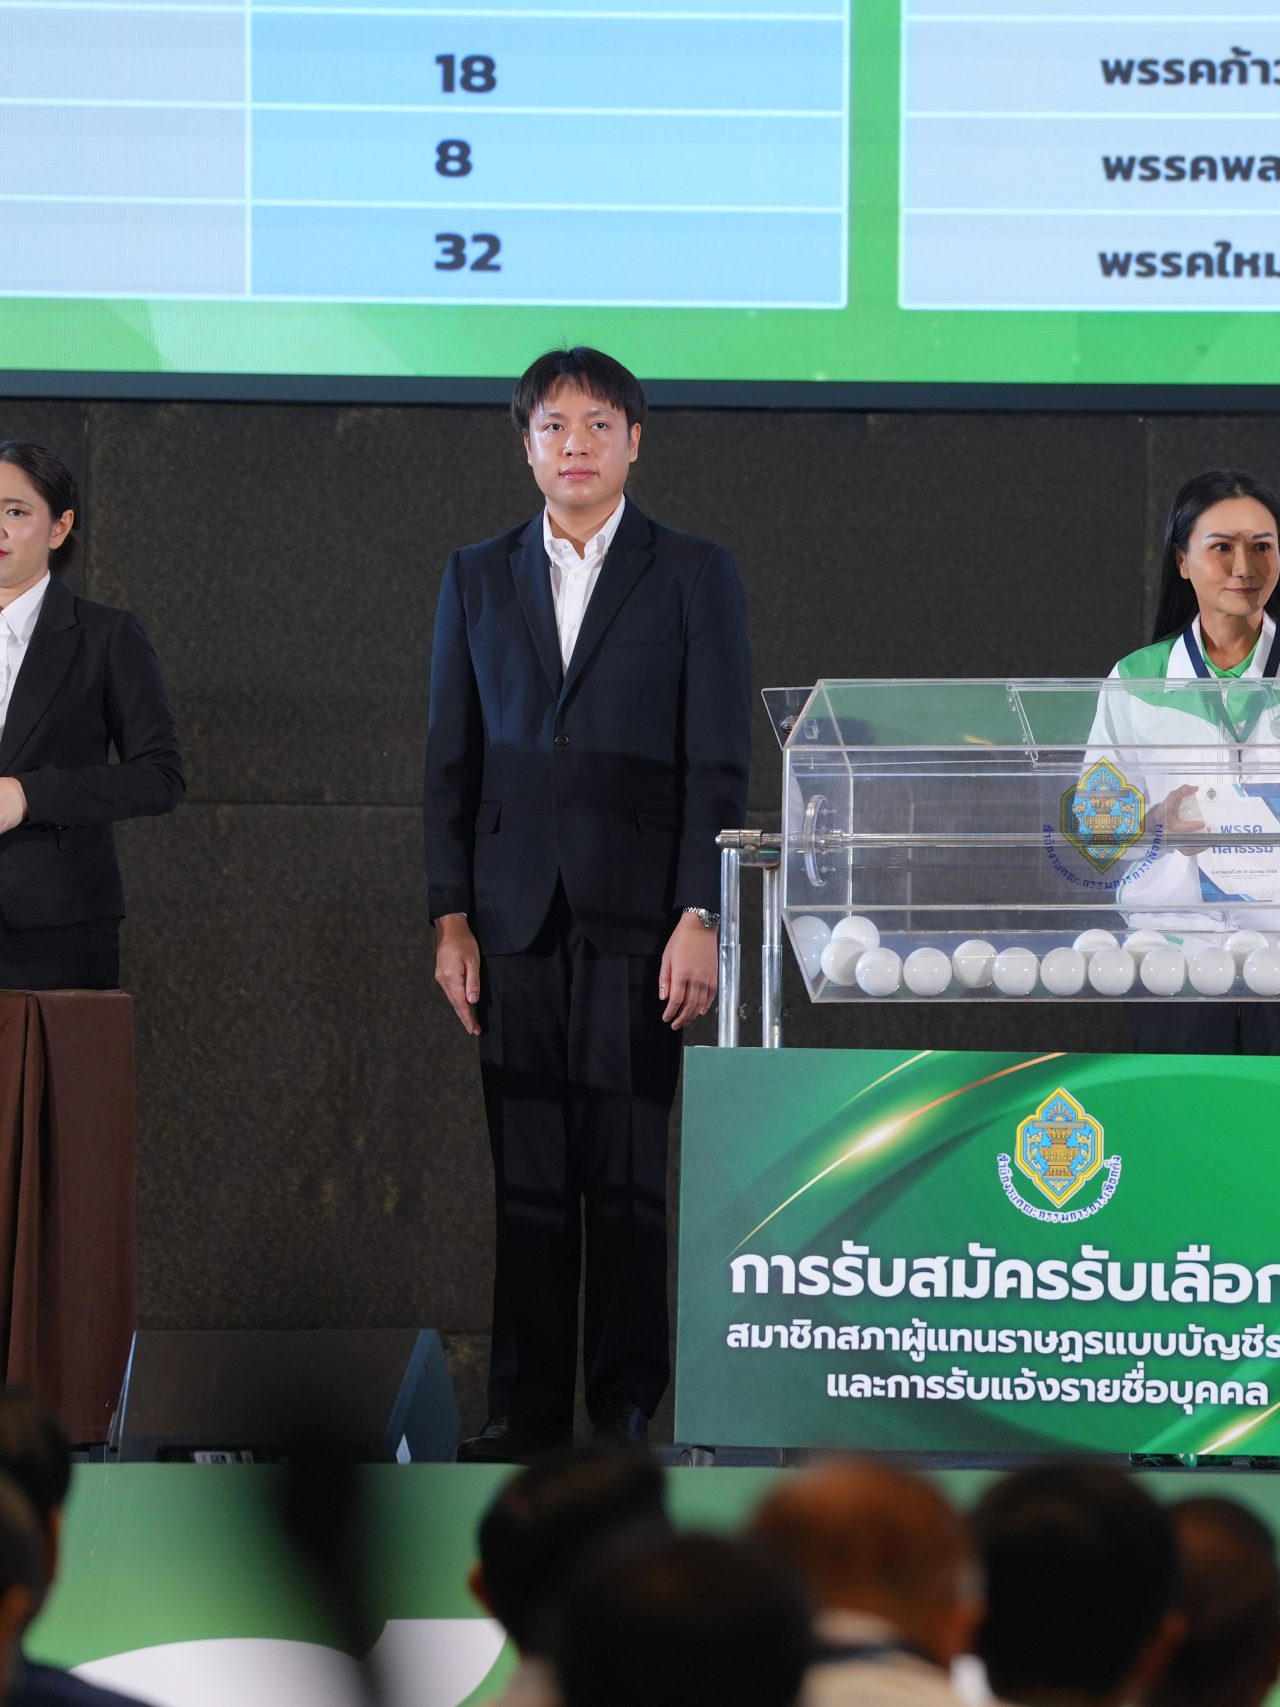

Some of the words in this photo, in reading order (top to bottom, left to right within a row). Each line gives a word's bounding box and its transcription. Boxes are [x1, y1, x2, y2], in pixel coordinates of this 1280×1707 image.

[436, 54, 497, 93] 18
[435, 139, 472, 177] 8
[435, 233, 501, 272] 32
[827, 1362, 1269, 1415] และการรับแจ้งรายชื่อบุคคล
